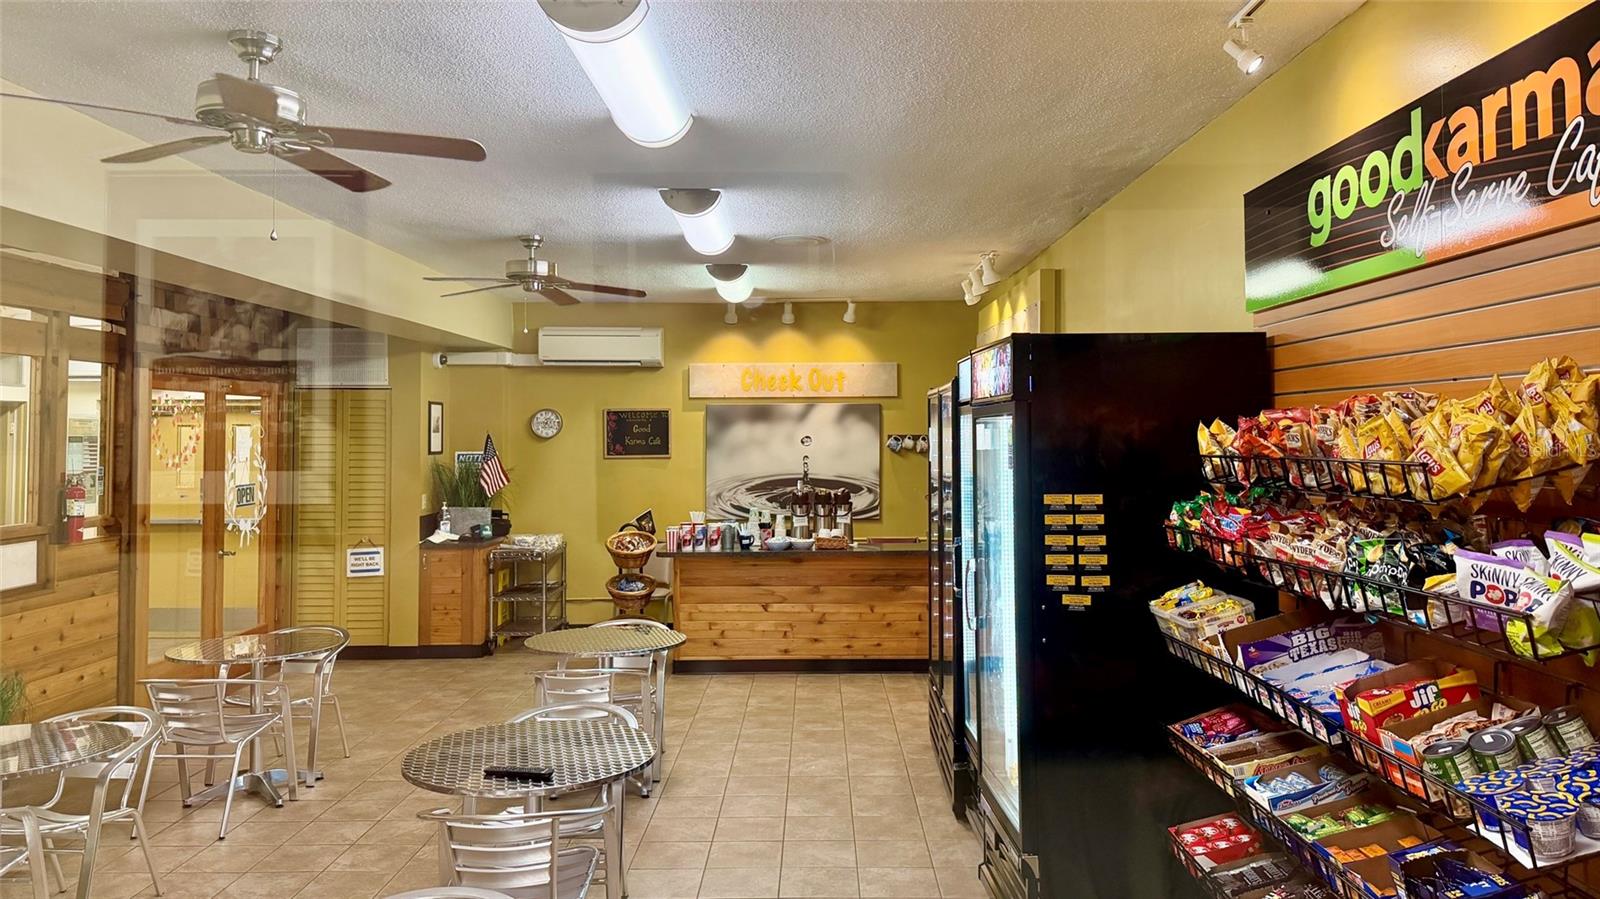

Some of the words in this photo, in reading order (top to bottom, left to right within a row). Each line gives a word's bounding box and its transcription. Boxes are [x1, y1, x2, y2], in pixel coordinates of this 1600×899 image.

[1380, 162, 1532, 258] Self-Serve
[741, 368, 802, 392] Check
[808, 368, 847, 392] Out
[633, 424, 651, 433] Good
[236, 486, 255, 505] OPEN
[1470, 580, 1518, 607] POP
[1291, 627, 1330, 647] BIG
[1289, 637, 1337, 662] TEXAS
[1409, 685, 1439, 709] Jif
